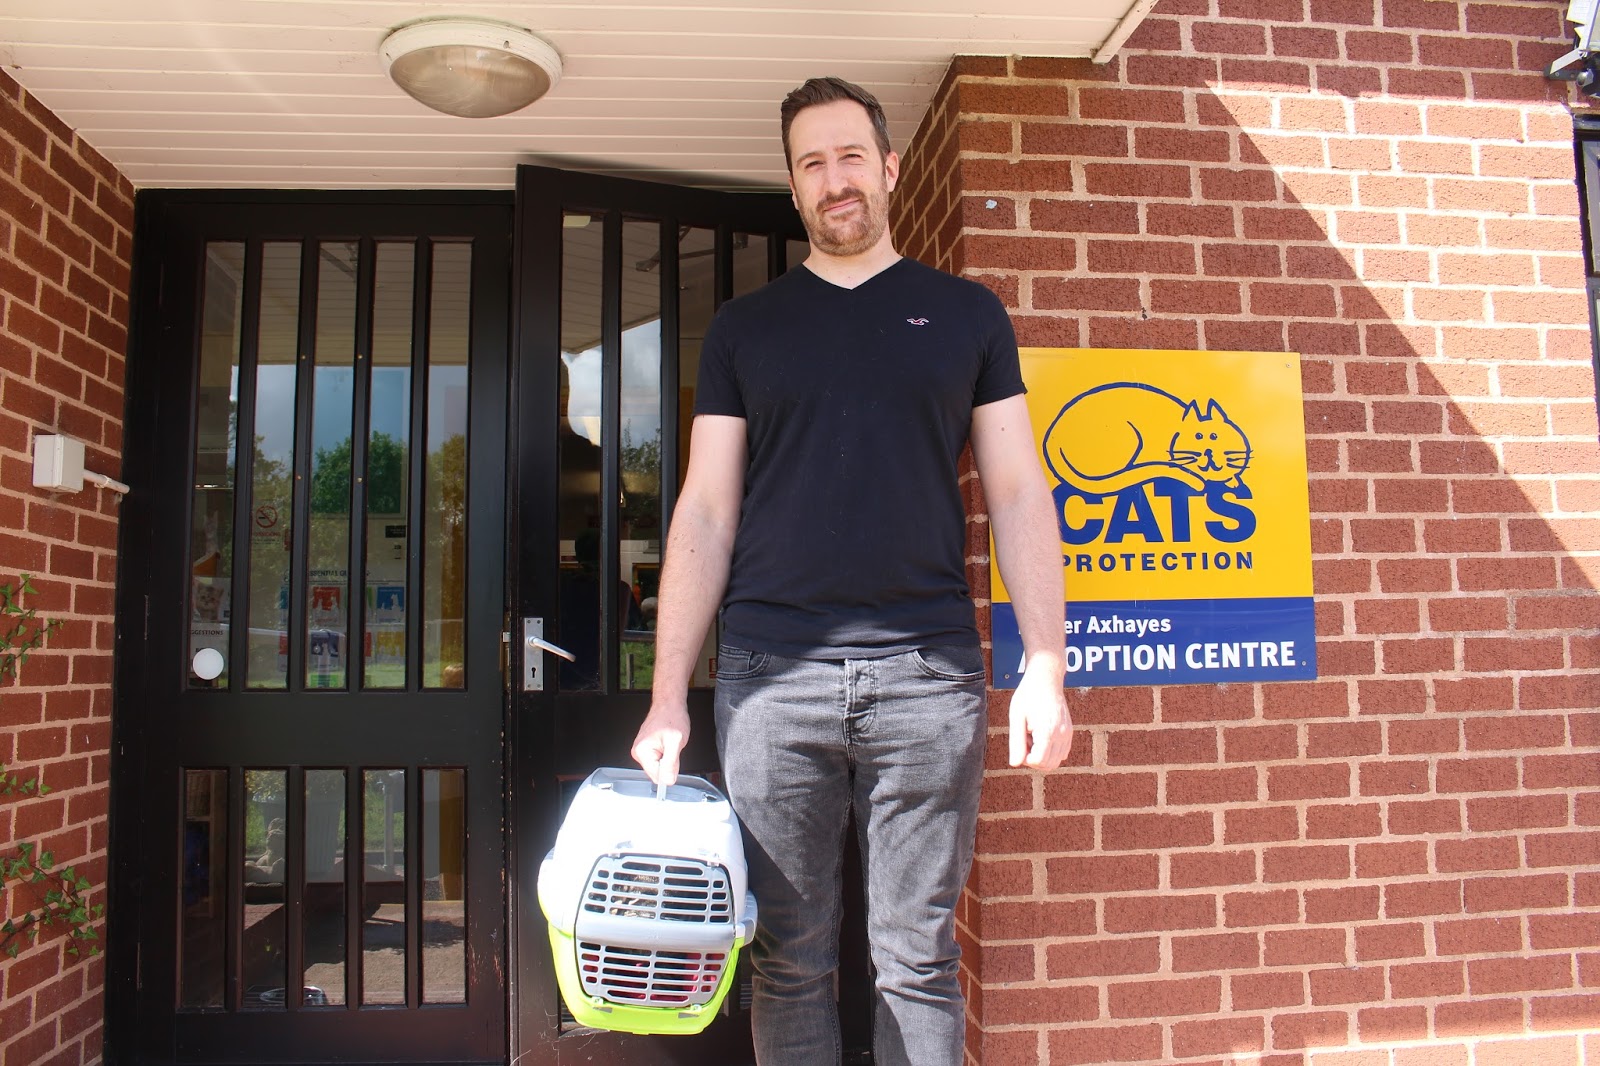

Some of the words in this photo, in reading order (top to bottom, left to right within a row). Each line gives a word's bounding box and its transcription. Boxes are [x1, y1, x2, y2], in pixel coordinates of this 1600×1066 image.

[1051, 476, 1256, 545] CATS
[1086, 614, 1172, 638] Axhayes
[1017, 643, 1176, 674] OPTION
[1185, 640, 1296, 670] CENTRE
